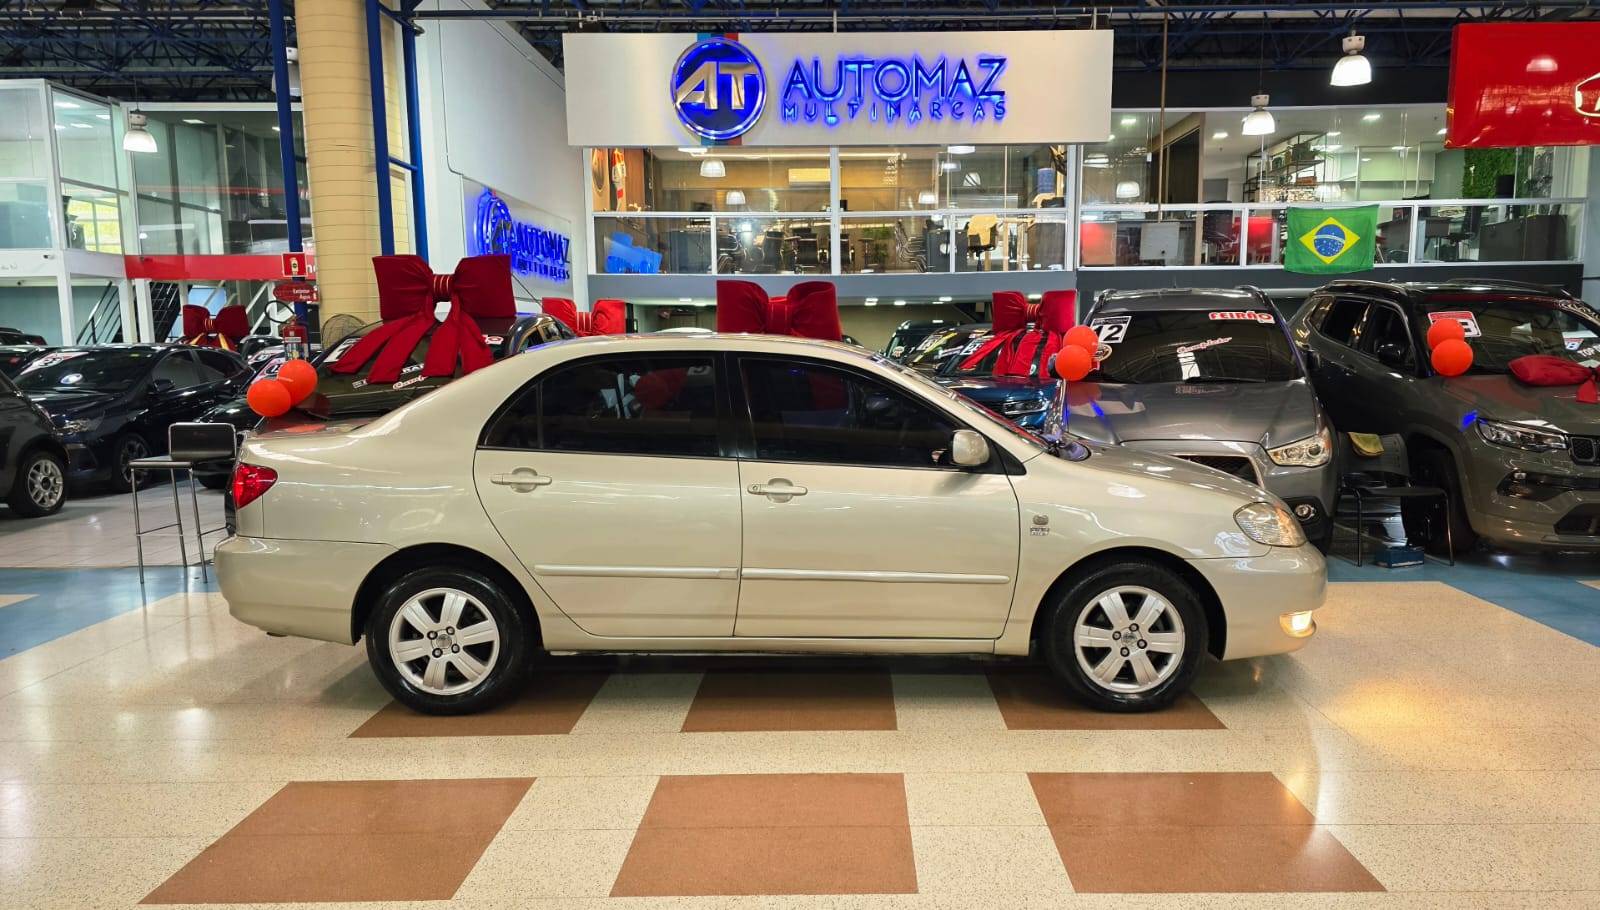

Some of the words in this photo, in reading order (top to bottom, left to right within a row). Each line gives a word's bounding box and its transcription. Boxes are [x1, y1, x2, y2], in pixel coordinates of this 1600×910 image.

[674, 60, 760, 110] AT
[783, 57, 1007, 101] AUTOMAZ
[782, 101, 1007, 123] MULTIMARCAS
